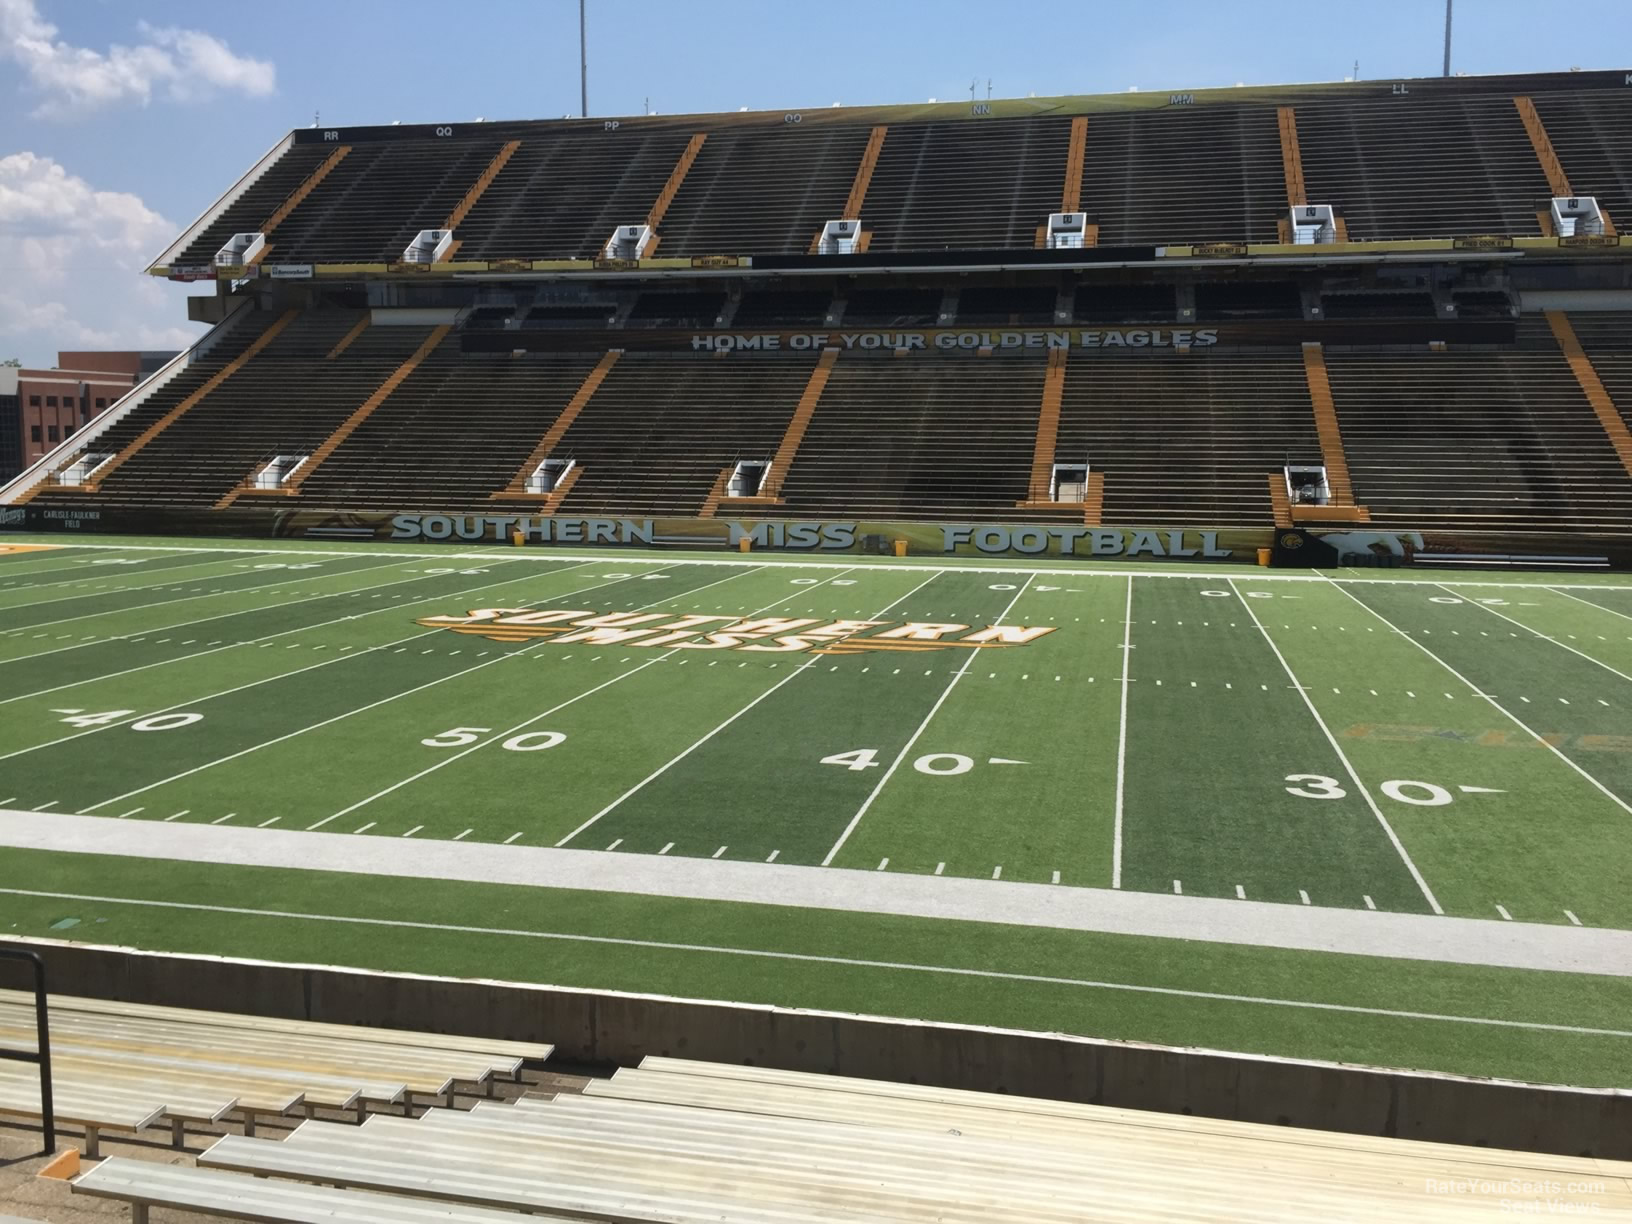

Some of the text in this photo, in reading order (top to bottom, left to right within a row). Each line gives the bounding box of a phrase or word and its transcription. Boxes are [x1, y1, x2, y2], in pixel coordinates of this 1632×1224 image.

[1392, 83, 1409, 94] LL
[1170, 94, 1194, 105] MM
[971, 105, 991, 116] NN
[604, 121, 619, 131] PP
[324, 131, 339, 141] RR
[436, 127, 452, 137] QQ
[691, 328, 1218, 350] HOME OF YOUR GOLDEN EAGLES
[64, 520, 80, 528] FIELD
[391, 515, 1233, 558] SOUTHERN MISS FOOTBALL
[424, 608, 1057, 643] SOUTHERN
[560, 626, 833, 653] MISS
